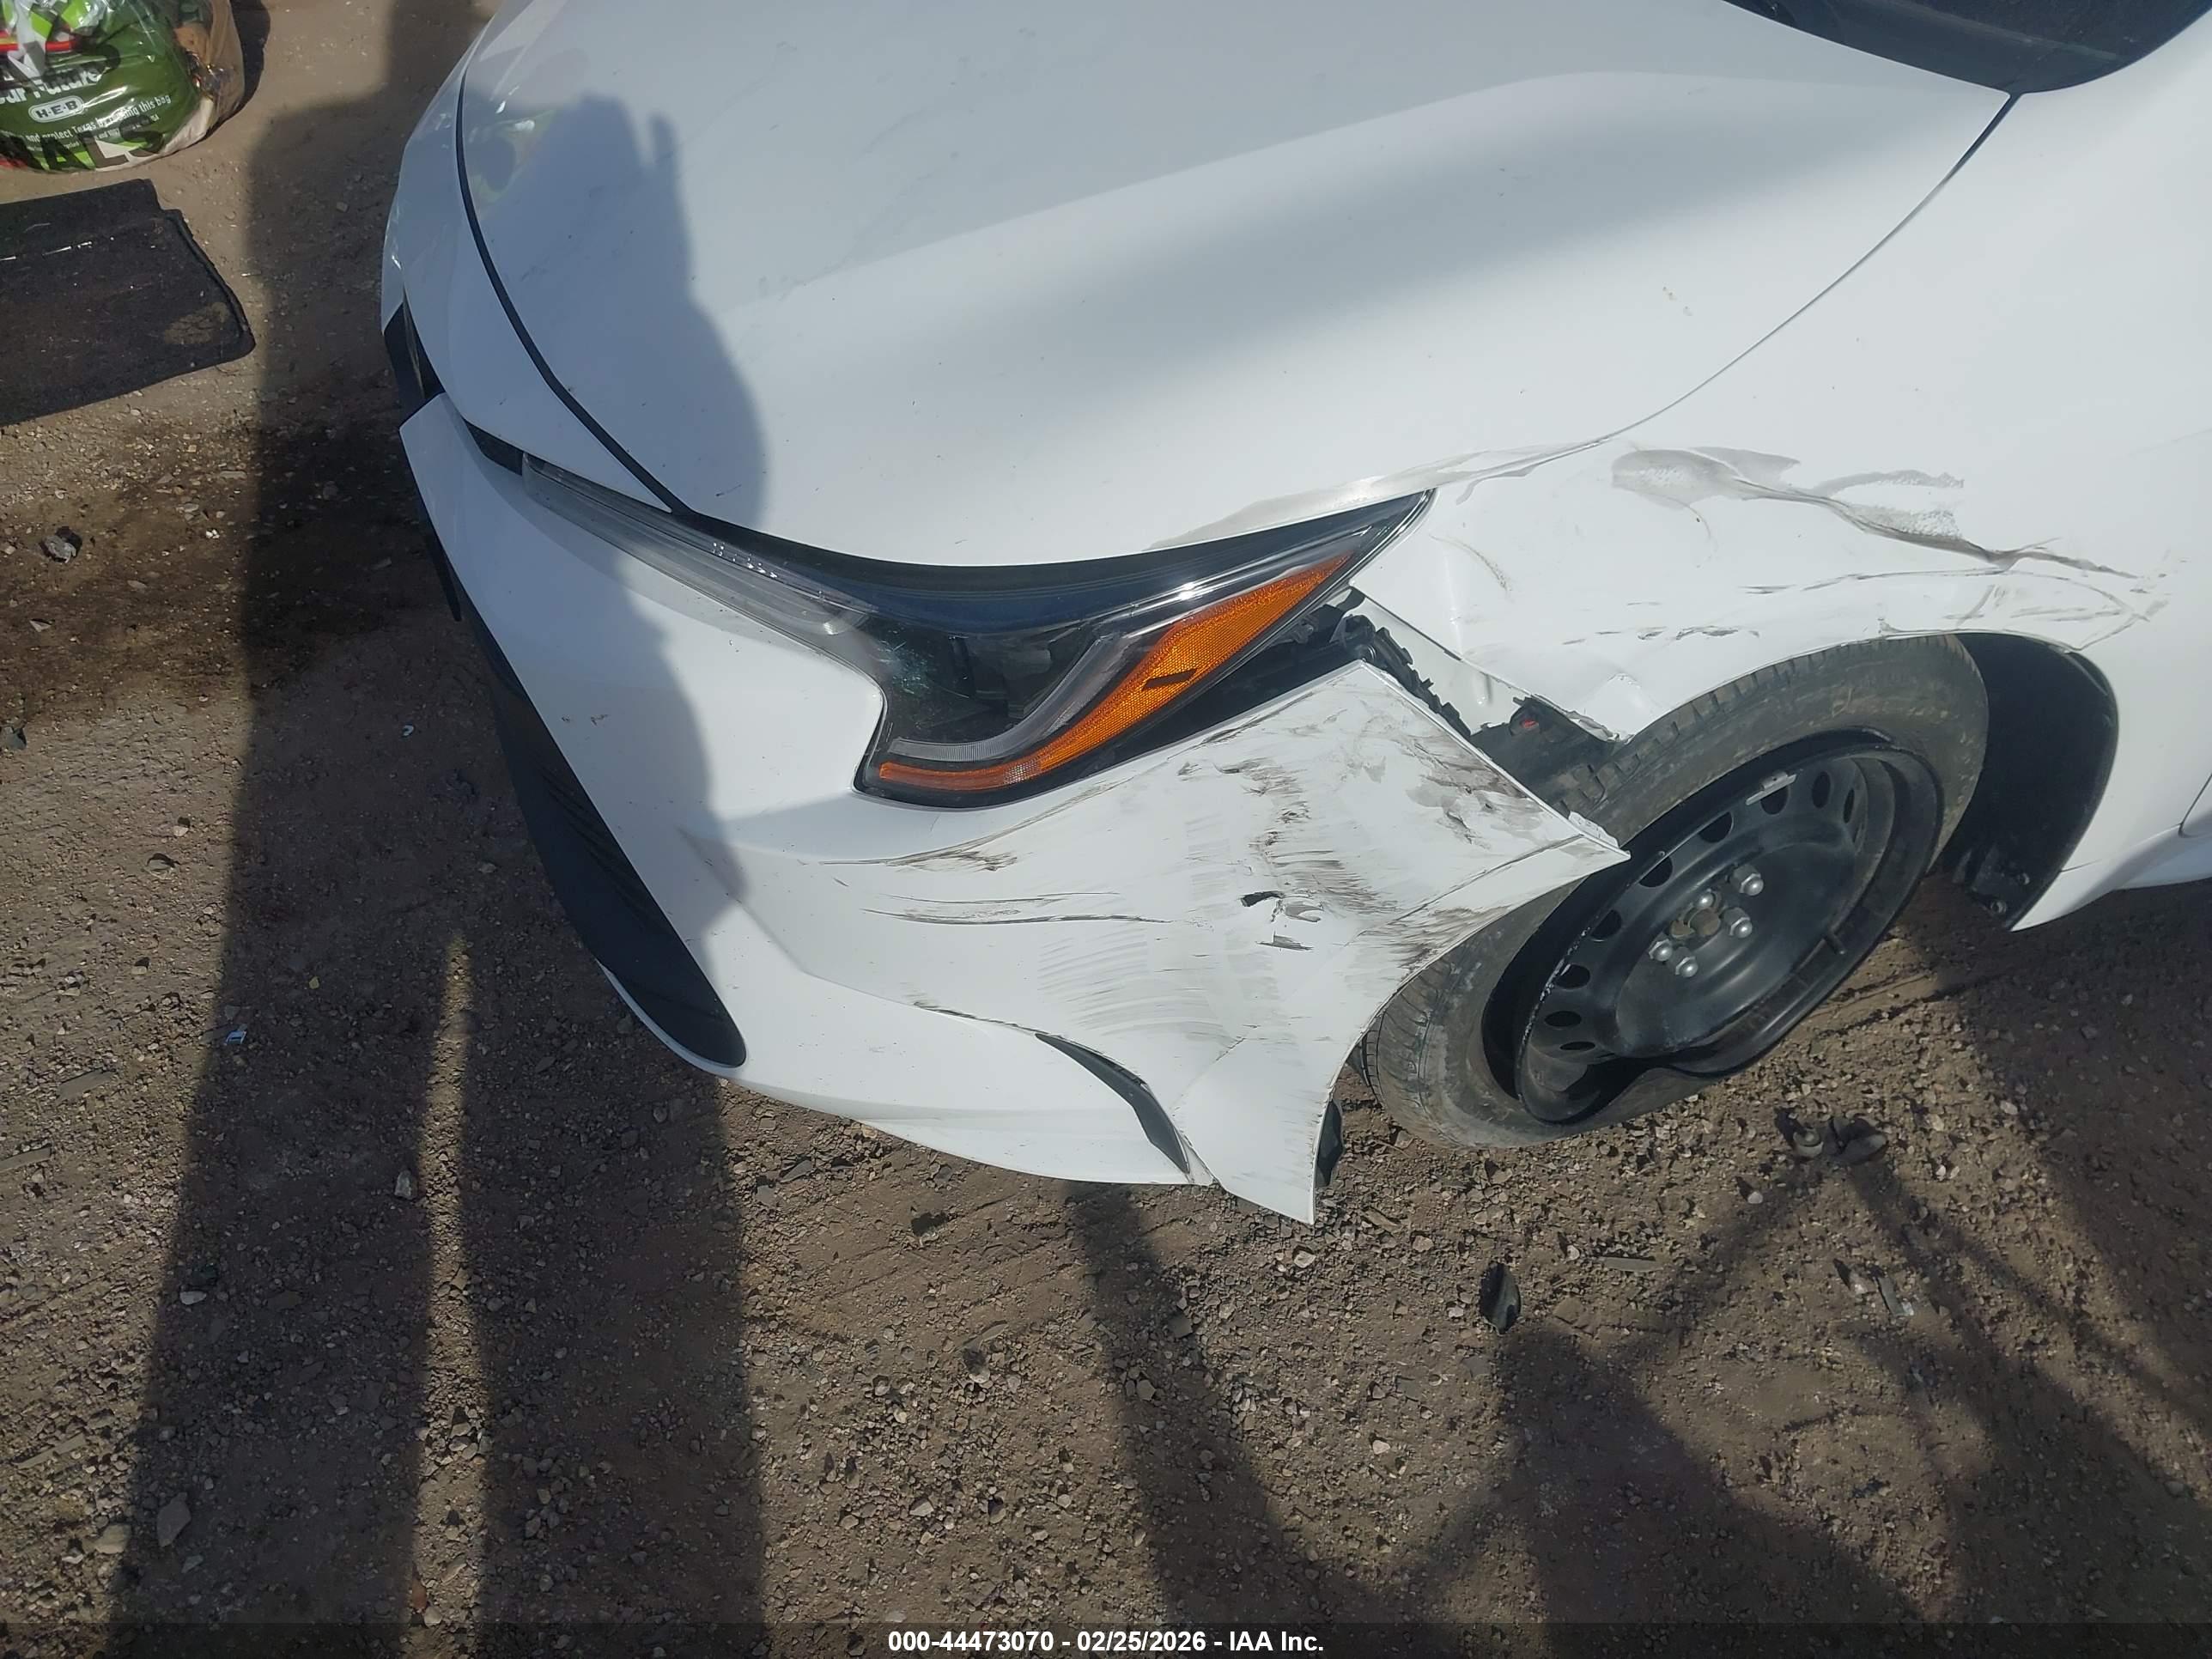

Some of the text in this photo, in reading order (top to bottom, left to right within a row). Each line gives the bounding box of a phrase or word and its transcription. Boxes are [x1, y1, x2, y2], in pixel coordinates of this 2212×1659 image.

[0, 88, 27, 104] ur
[71, 118, 98, 134] Texas
[138, 100, 156, 113] this
[154, 94, 172, 106] bag
